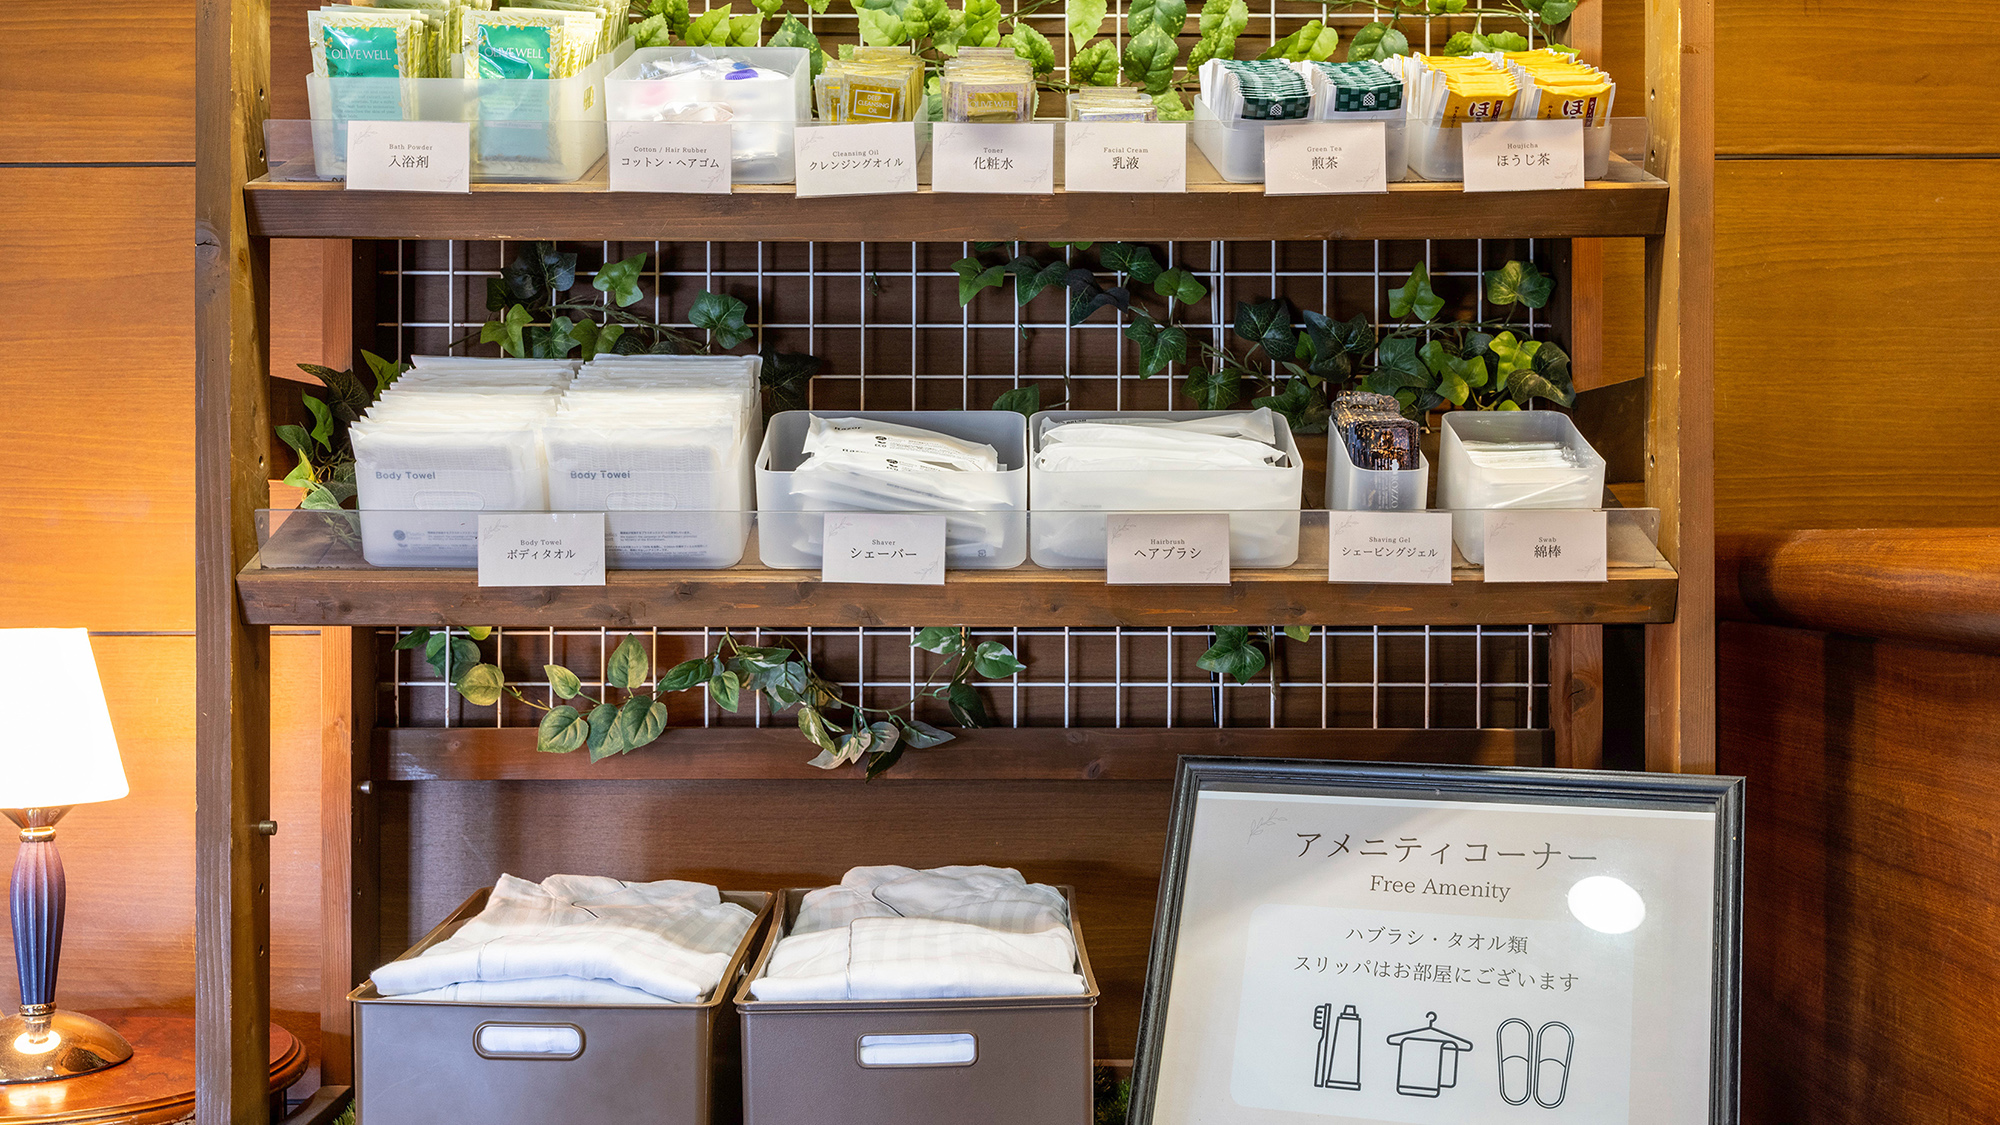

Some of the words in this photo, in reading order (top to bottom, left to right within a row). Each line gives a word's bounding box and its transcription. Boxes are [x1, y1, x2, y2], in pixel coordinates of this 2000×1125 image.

[857, 100, 890, 109] CLEANSING
[1507, 142, 1539, 150] Houjicha
[832, 150, 867, 158] Cleansing
[1497, 153, 1551, 167] ほうじ茶
[388, 154, 429, 169] 入浴剤
[621, 156, 720, 168] コットン・ヘアゴム
[809, 157, 904, 171] クレンジングオイル
[973, 156, 1014, 170] 化粧水
[1112, 156, 1140, 170] 乳液
[1311, 156, 1338, 170] 煎茶
[375, 471, 402, 480] Body
[405, 471, 436, 479] Towel
[570, 470, 597, 480] Body
[507, 548, 576, 560] ボディタオル
[850, 547, 917, 559] シェーバー
[1134, 546, 1202, 560] ヘアブラシ
[1341, 546, 1438, 558] シェービングジェル
[1534, 544, 1561, 558] 綿棒
[1296, 832, 1597, 870] アメニティコーナー
[1369, 875, 1416, 894] Free
[1422, 878, 1511, 903] Amenity
[1345, 926, 1529, 955] ハブラシ・タオル類
[1293, 955, 1579, 993] スリッパはお部屋にございます
